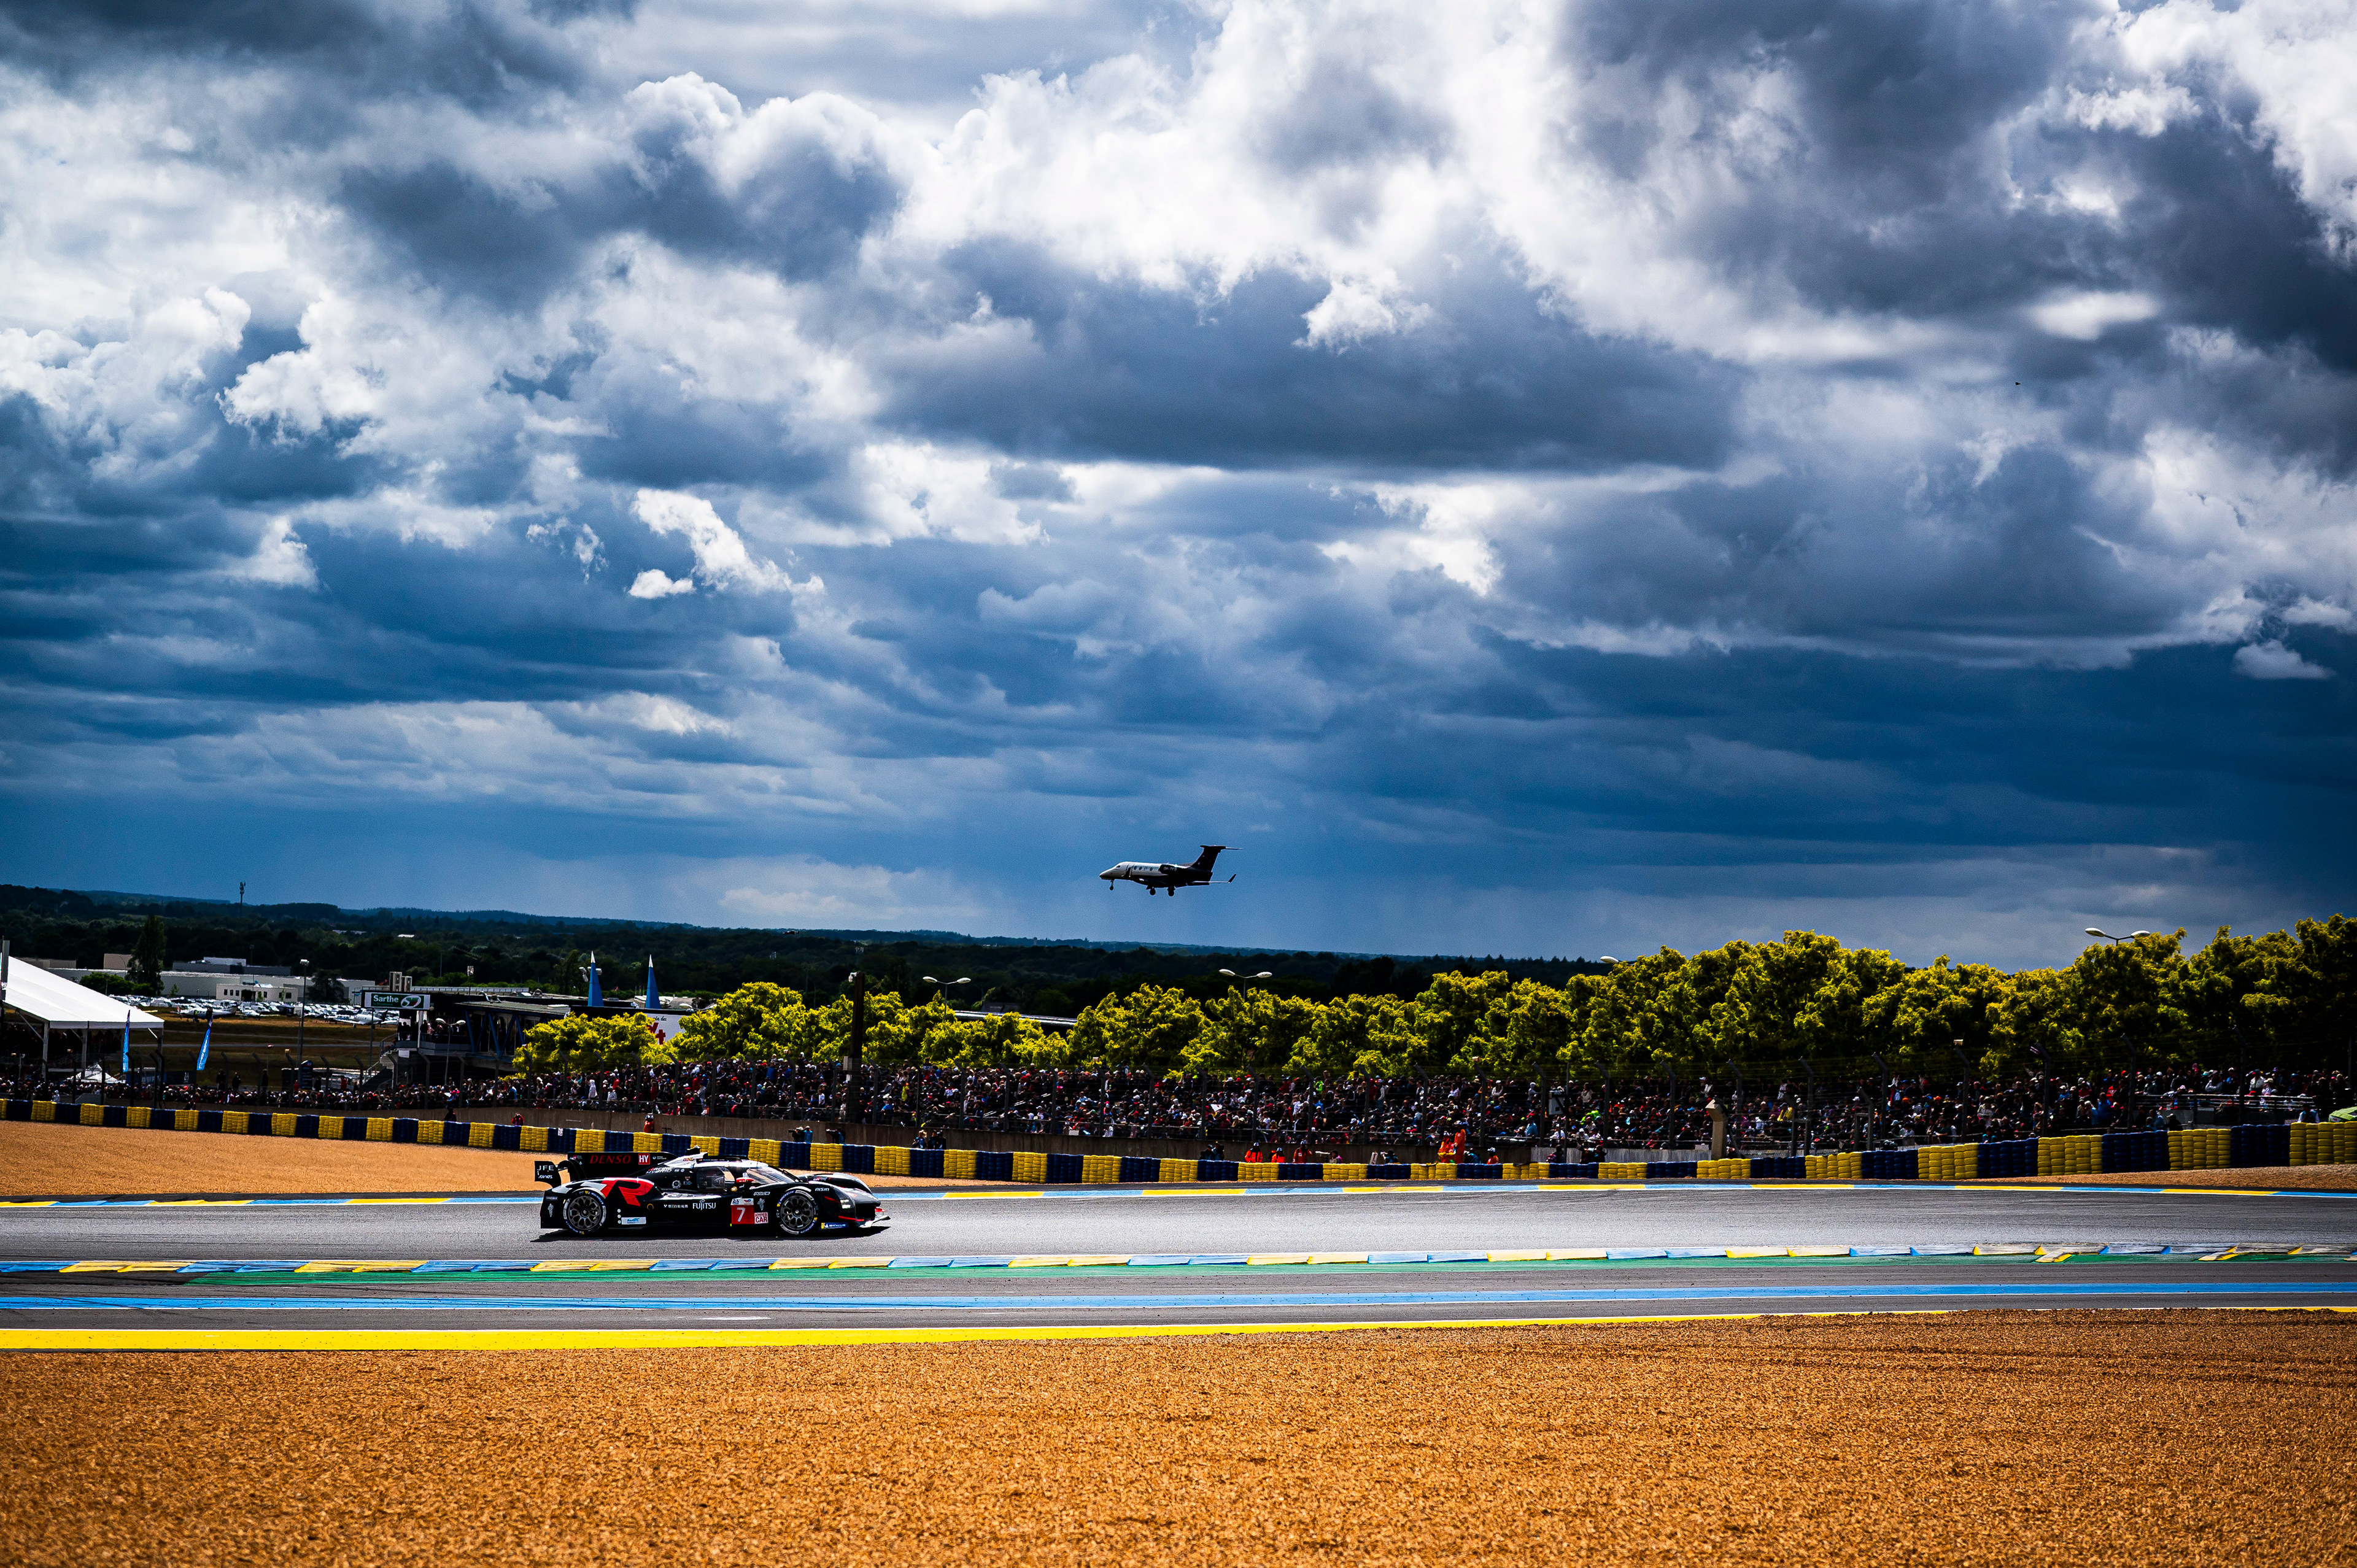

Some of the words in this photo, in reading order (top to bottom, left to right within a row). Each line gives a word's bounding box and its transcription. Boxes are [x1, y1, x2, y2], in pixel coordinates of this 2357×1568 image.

[590, 1155, 631, 1164] DENSO
[692, 1199, 716, 1211] FUJITSU
[737, 1207, 746, 1222] 7
